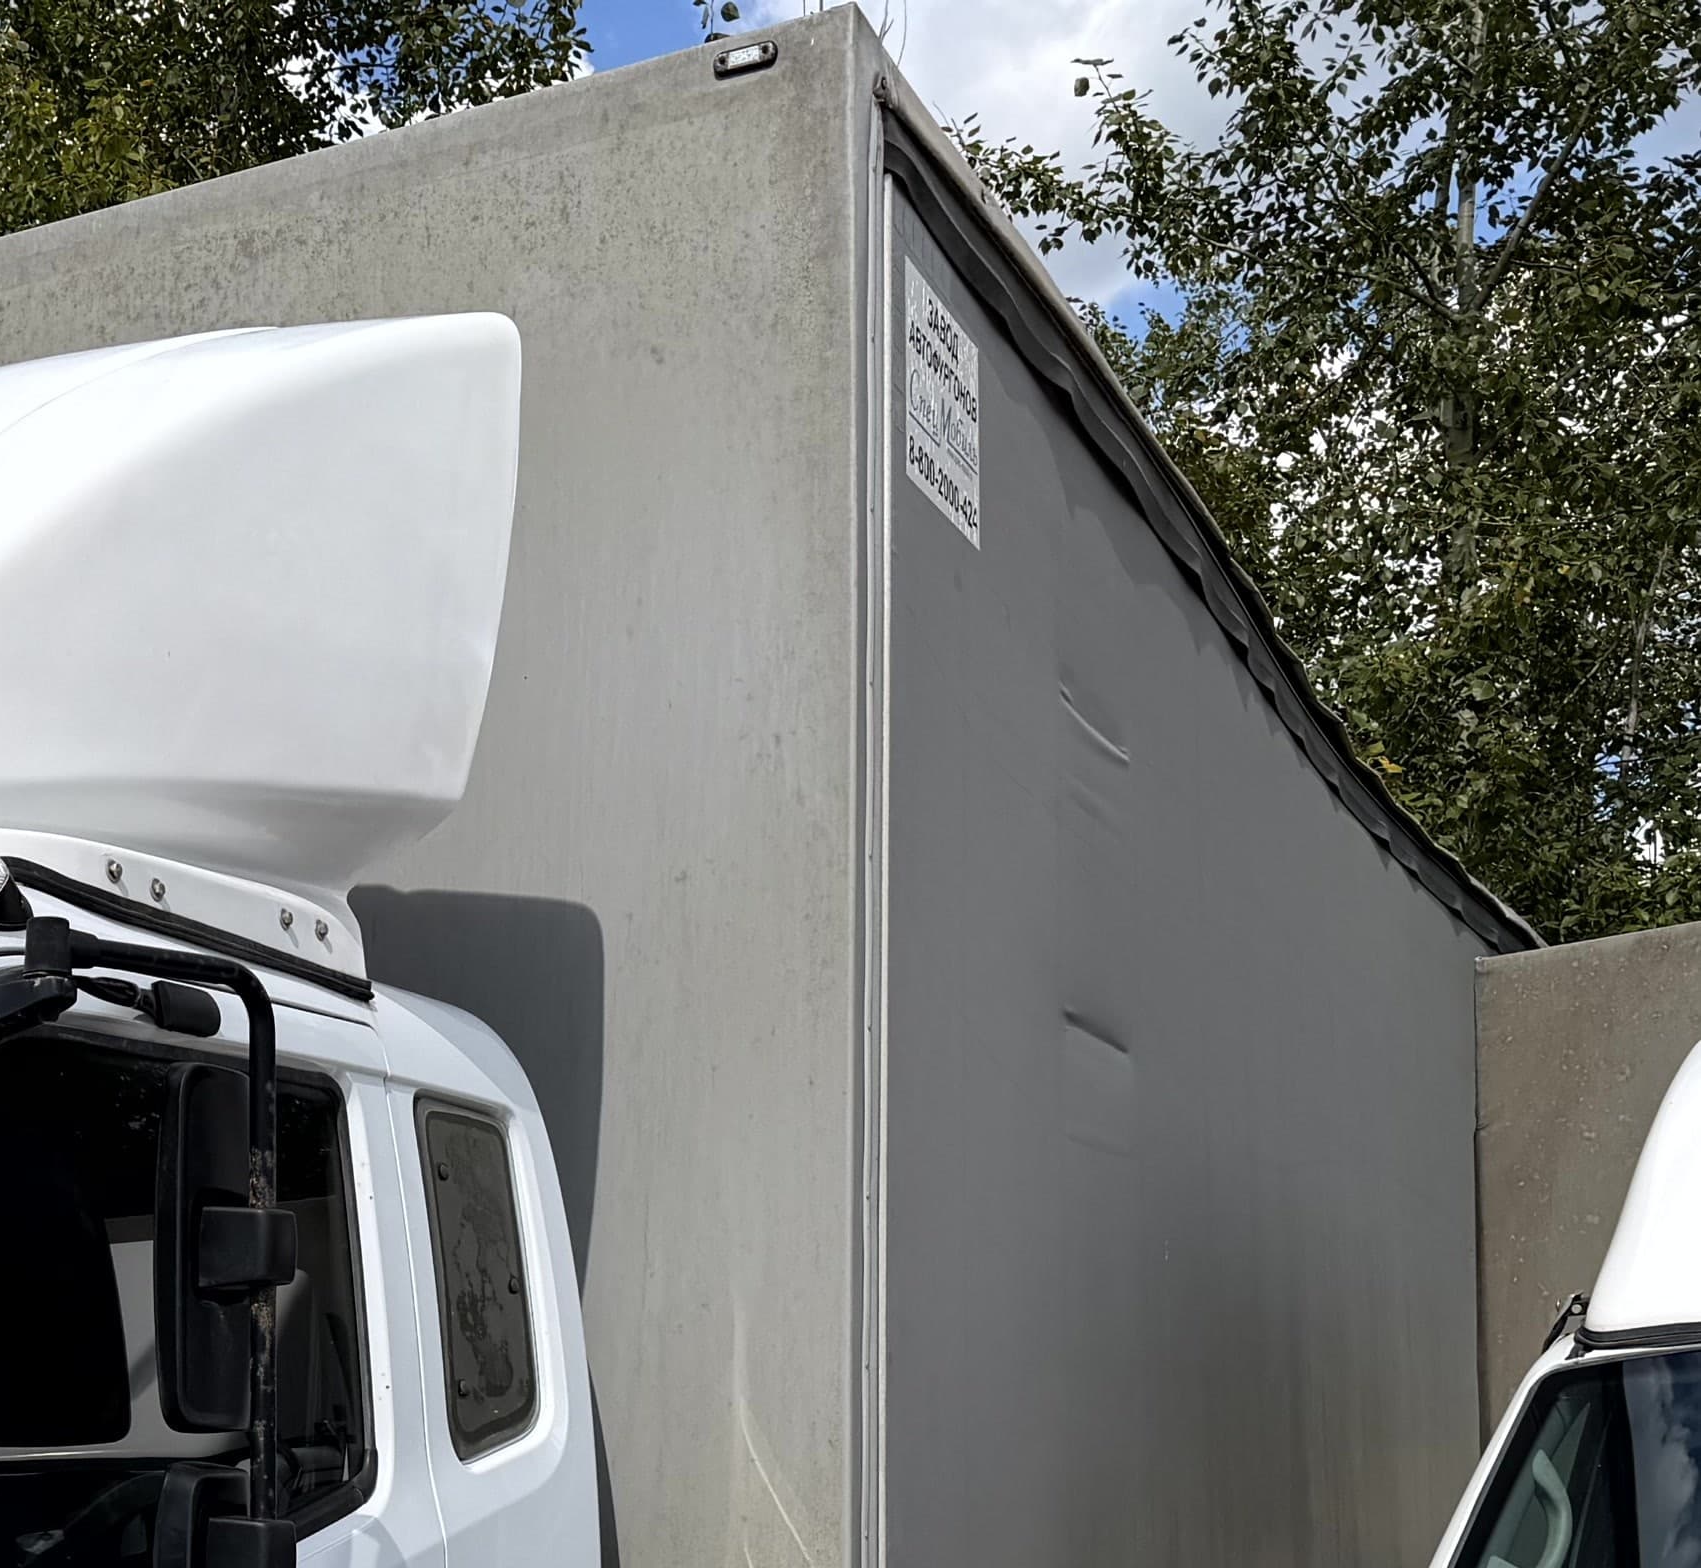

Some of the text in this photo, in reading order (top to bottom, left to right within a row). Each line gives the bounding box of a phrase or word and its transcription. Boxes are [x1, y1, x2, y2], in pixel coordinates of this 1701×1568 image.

[908, 320, 978, 423] АВТОФУРГОНОВ
[927, 298, 959, 368] ЗАВОД
[908, 435, 978, 529] 8-800-2000-424
